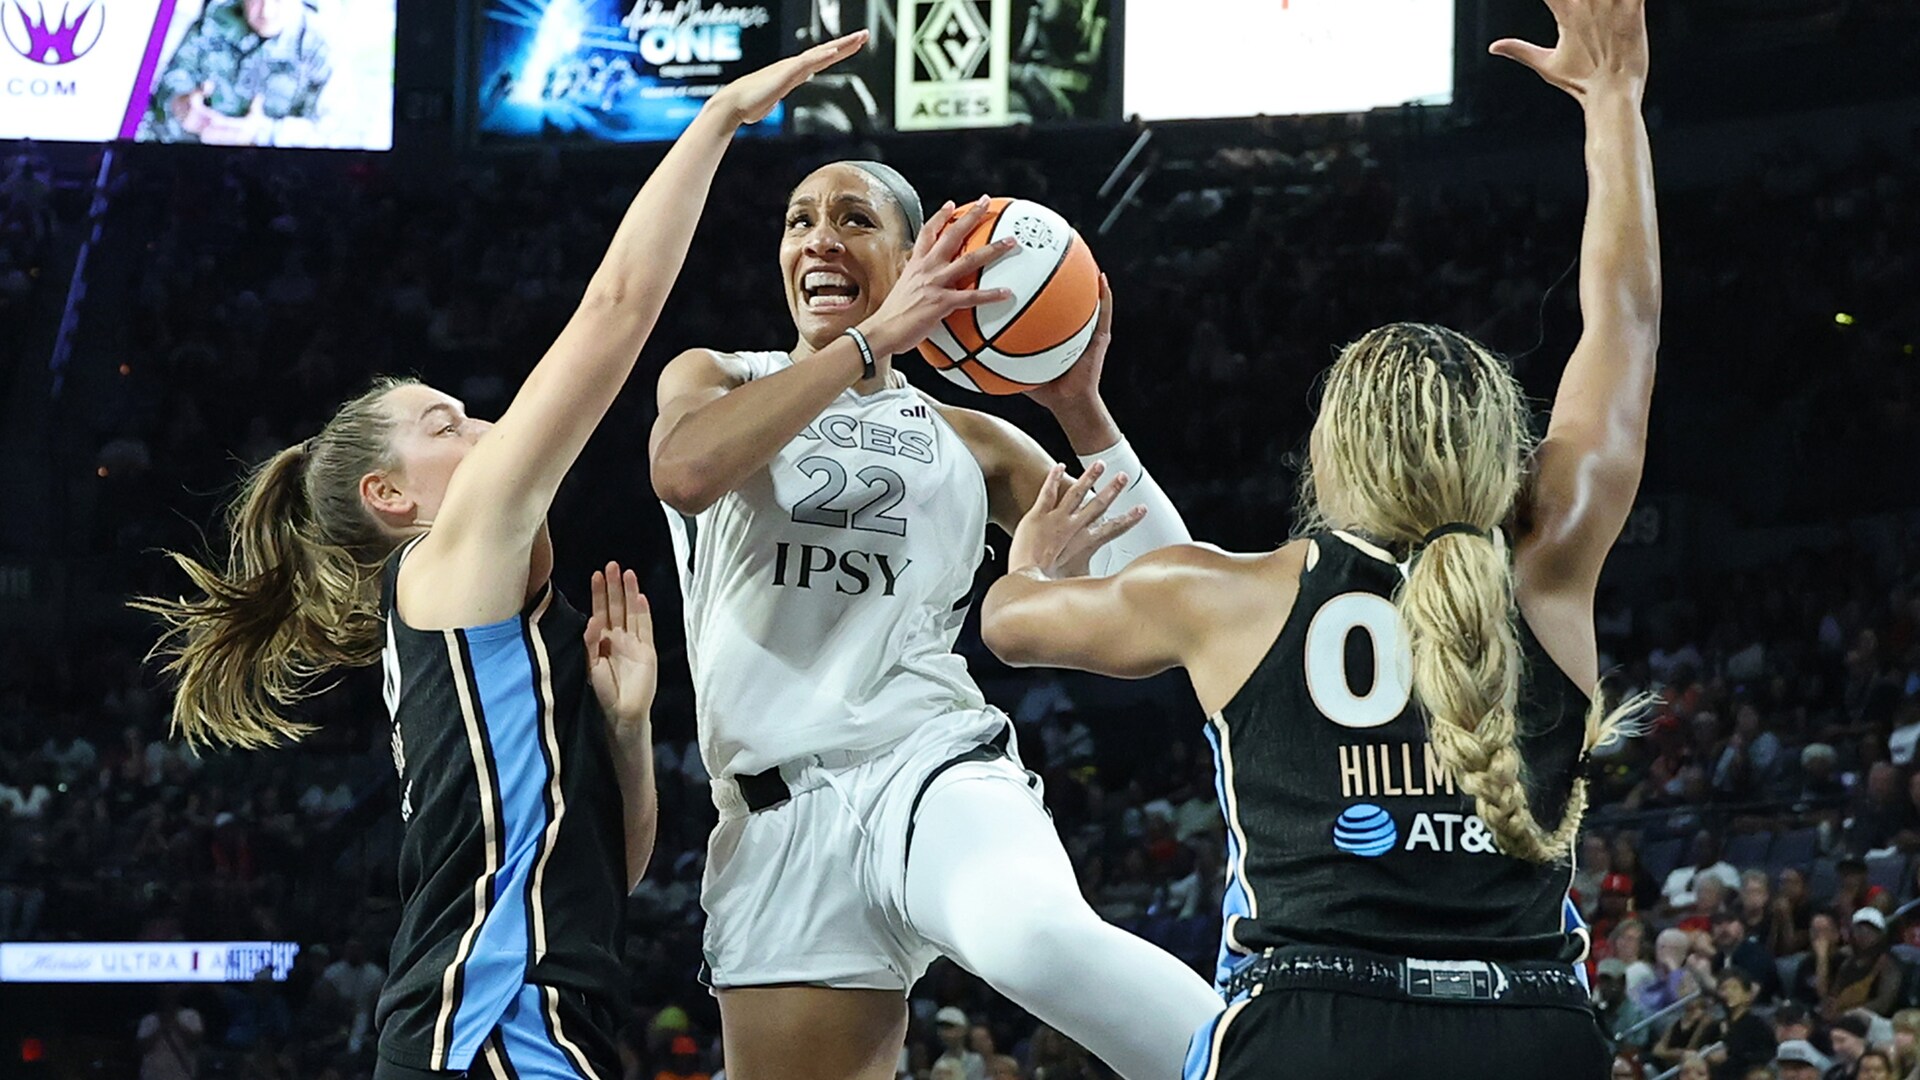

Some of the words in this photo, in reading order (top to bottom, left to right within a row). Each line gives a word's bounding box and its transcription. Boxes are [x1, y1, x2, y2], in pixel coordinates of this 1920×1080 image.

[640, 24, 742, 66] ONE
[7, 77, 77, 97] COM
[911, 97, 991, 119] ACES
[900, 405, 927, 419] all
[791, 456, 907, 537] 22
[772, 542, 912, 596] IPSY
[1304, 592, 1413, 728] 0
[1339, 742, 1455, 797] HILLM
[1404, 812, 1497, 855] AT&
[101, 951, 179, 973] ULTRA
